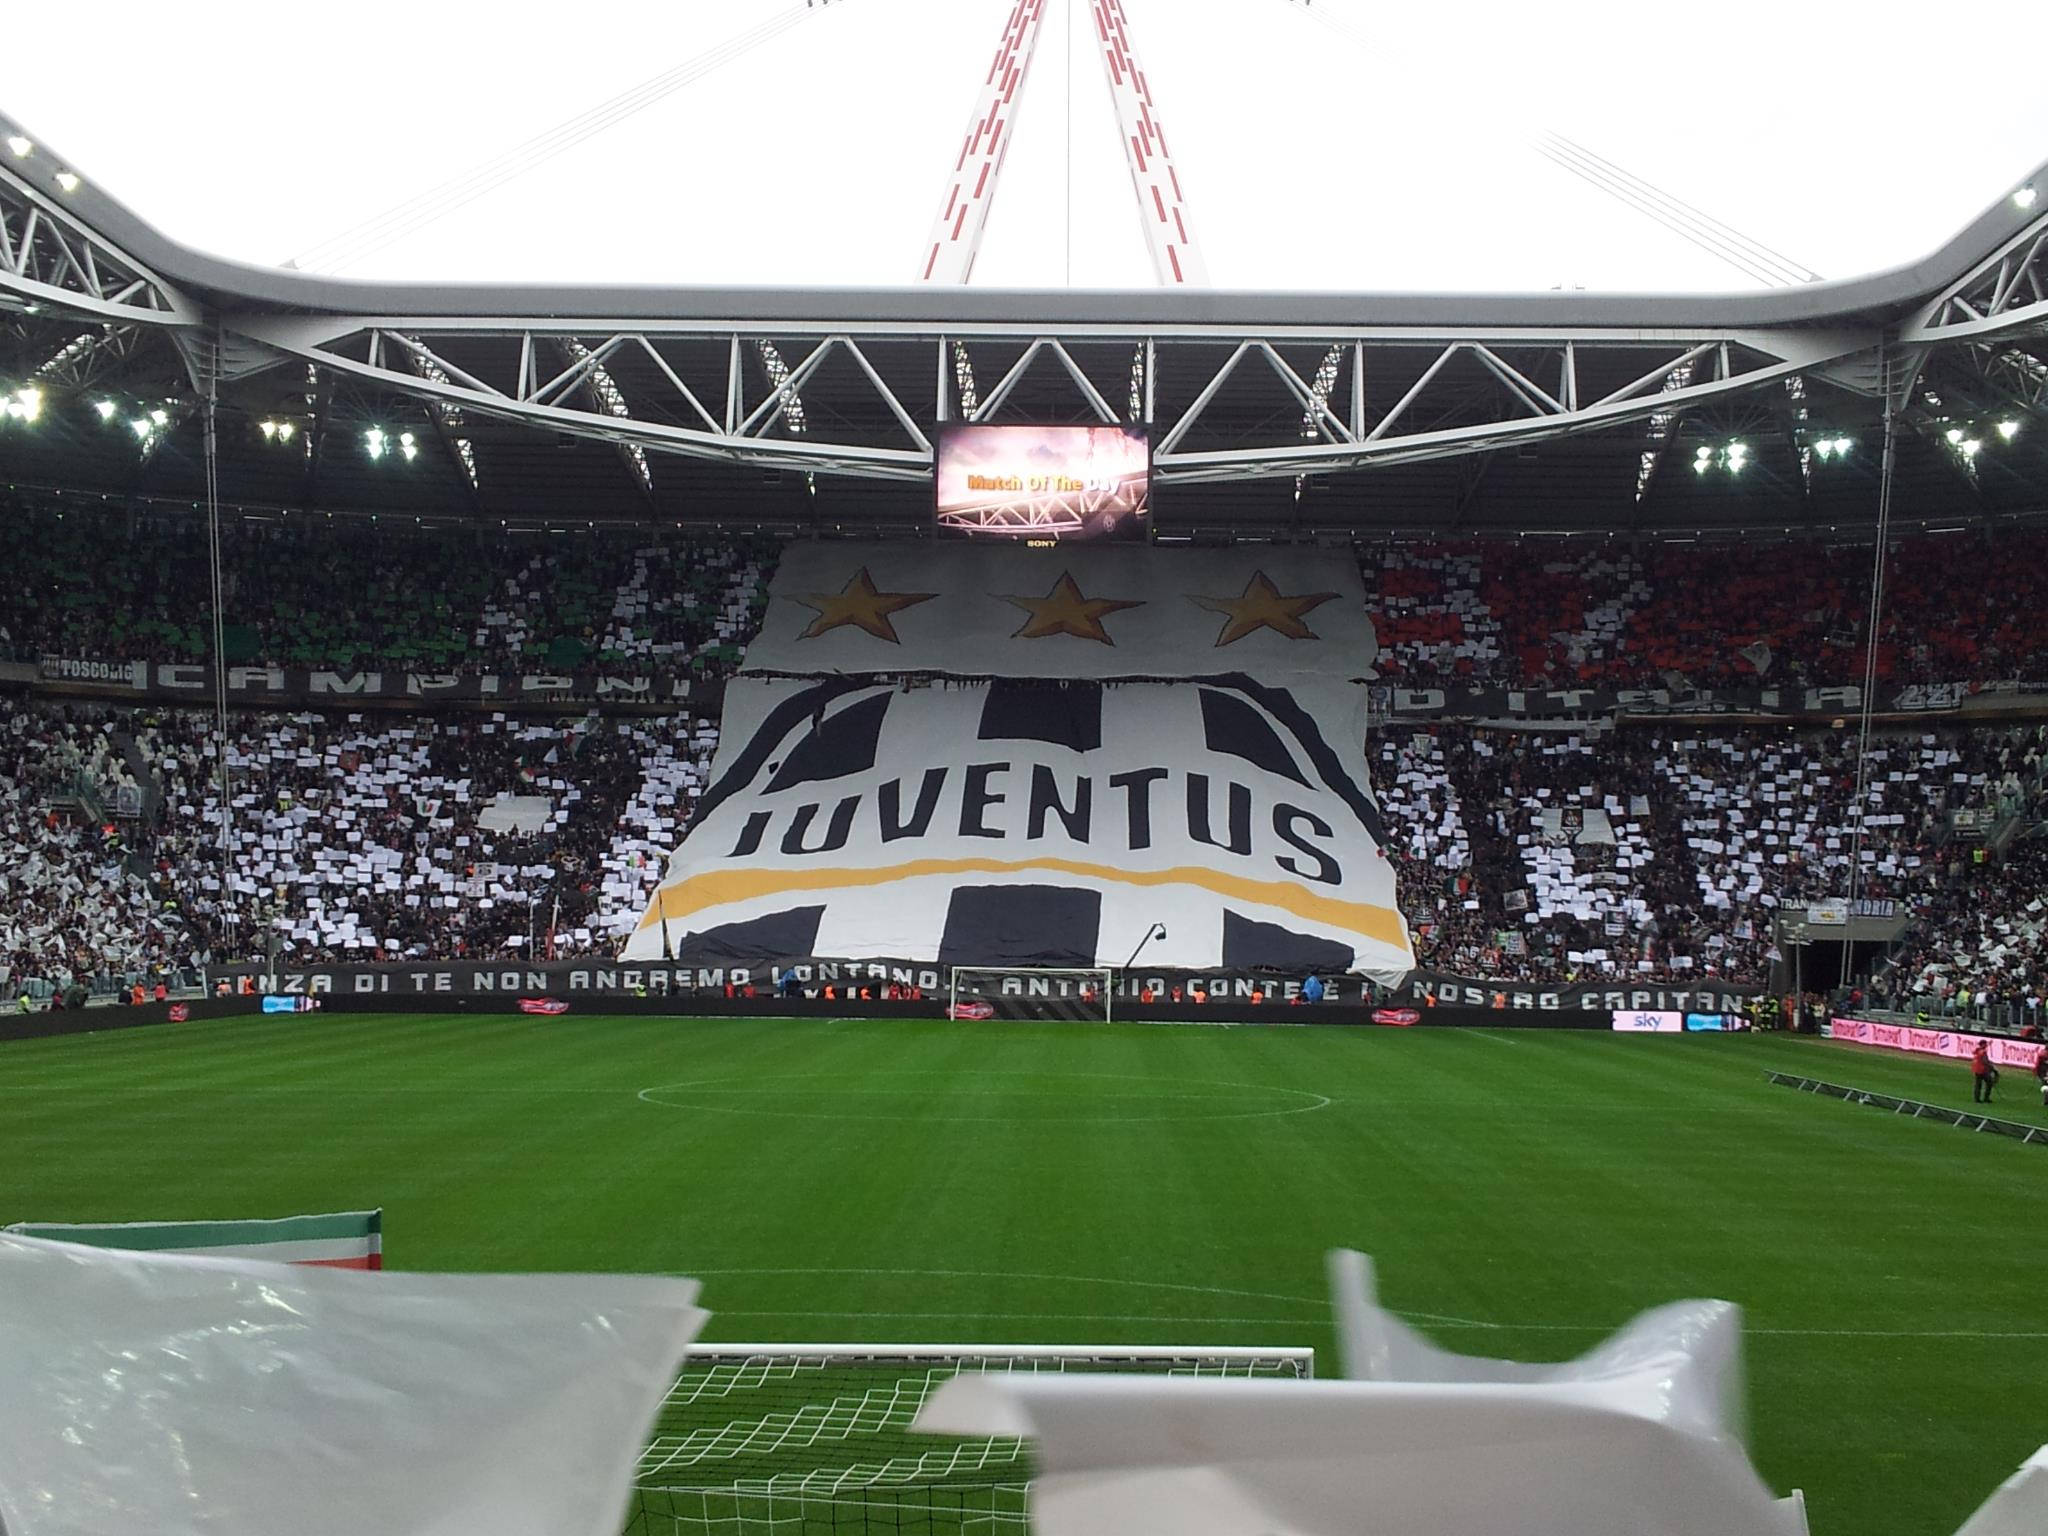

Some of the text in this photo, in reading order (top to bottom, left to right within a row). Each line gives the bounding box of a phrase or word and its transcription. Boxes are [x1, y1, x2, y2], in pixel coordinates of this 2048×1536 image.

[968, 475, 1022, 491] Match
[1028, 475, 1048, 491] Of
[1053, 475, 1083, 491] The
[725, 762, 1342, 885] JUVENTUS
[355, 974, 389, 993] DI
[411, 973, 452, 991] TE
[474, 972, 547, 991] NON
[570, 968, 750, 989] ANDREMO
[1187, 978, 1301, 999] CONTE
[1634, 1013, 1663, 1031] sky
